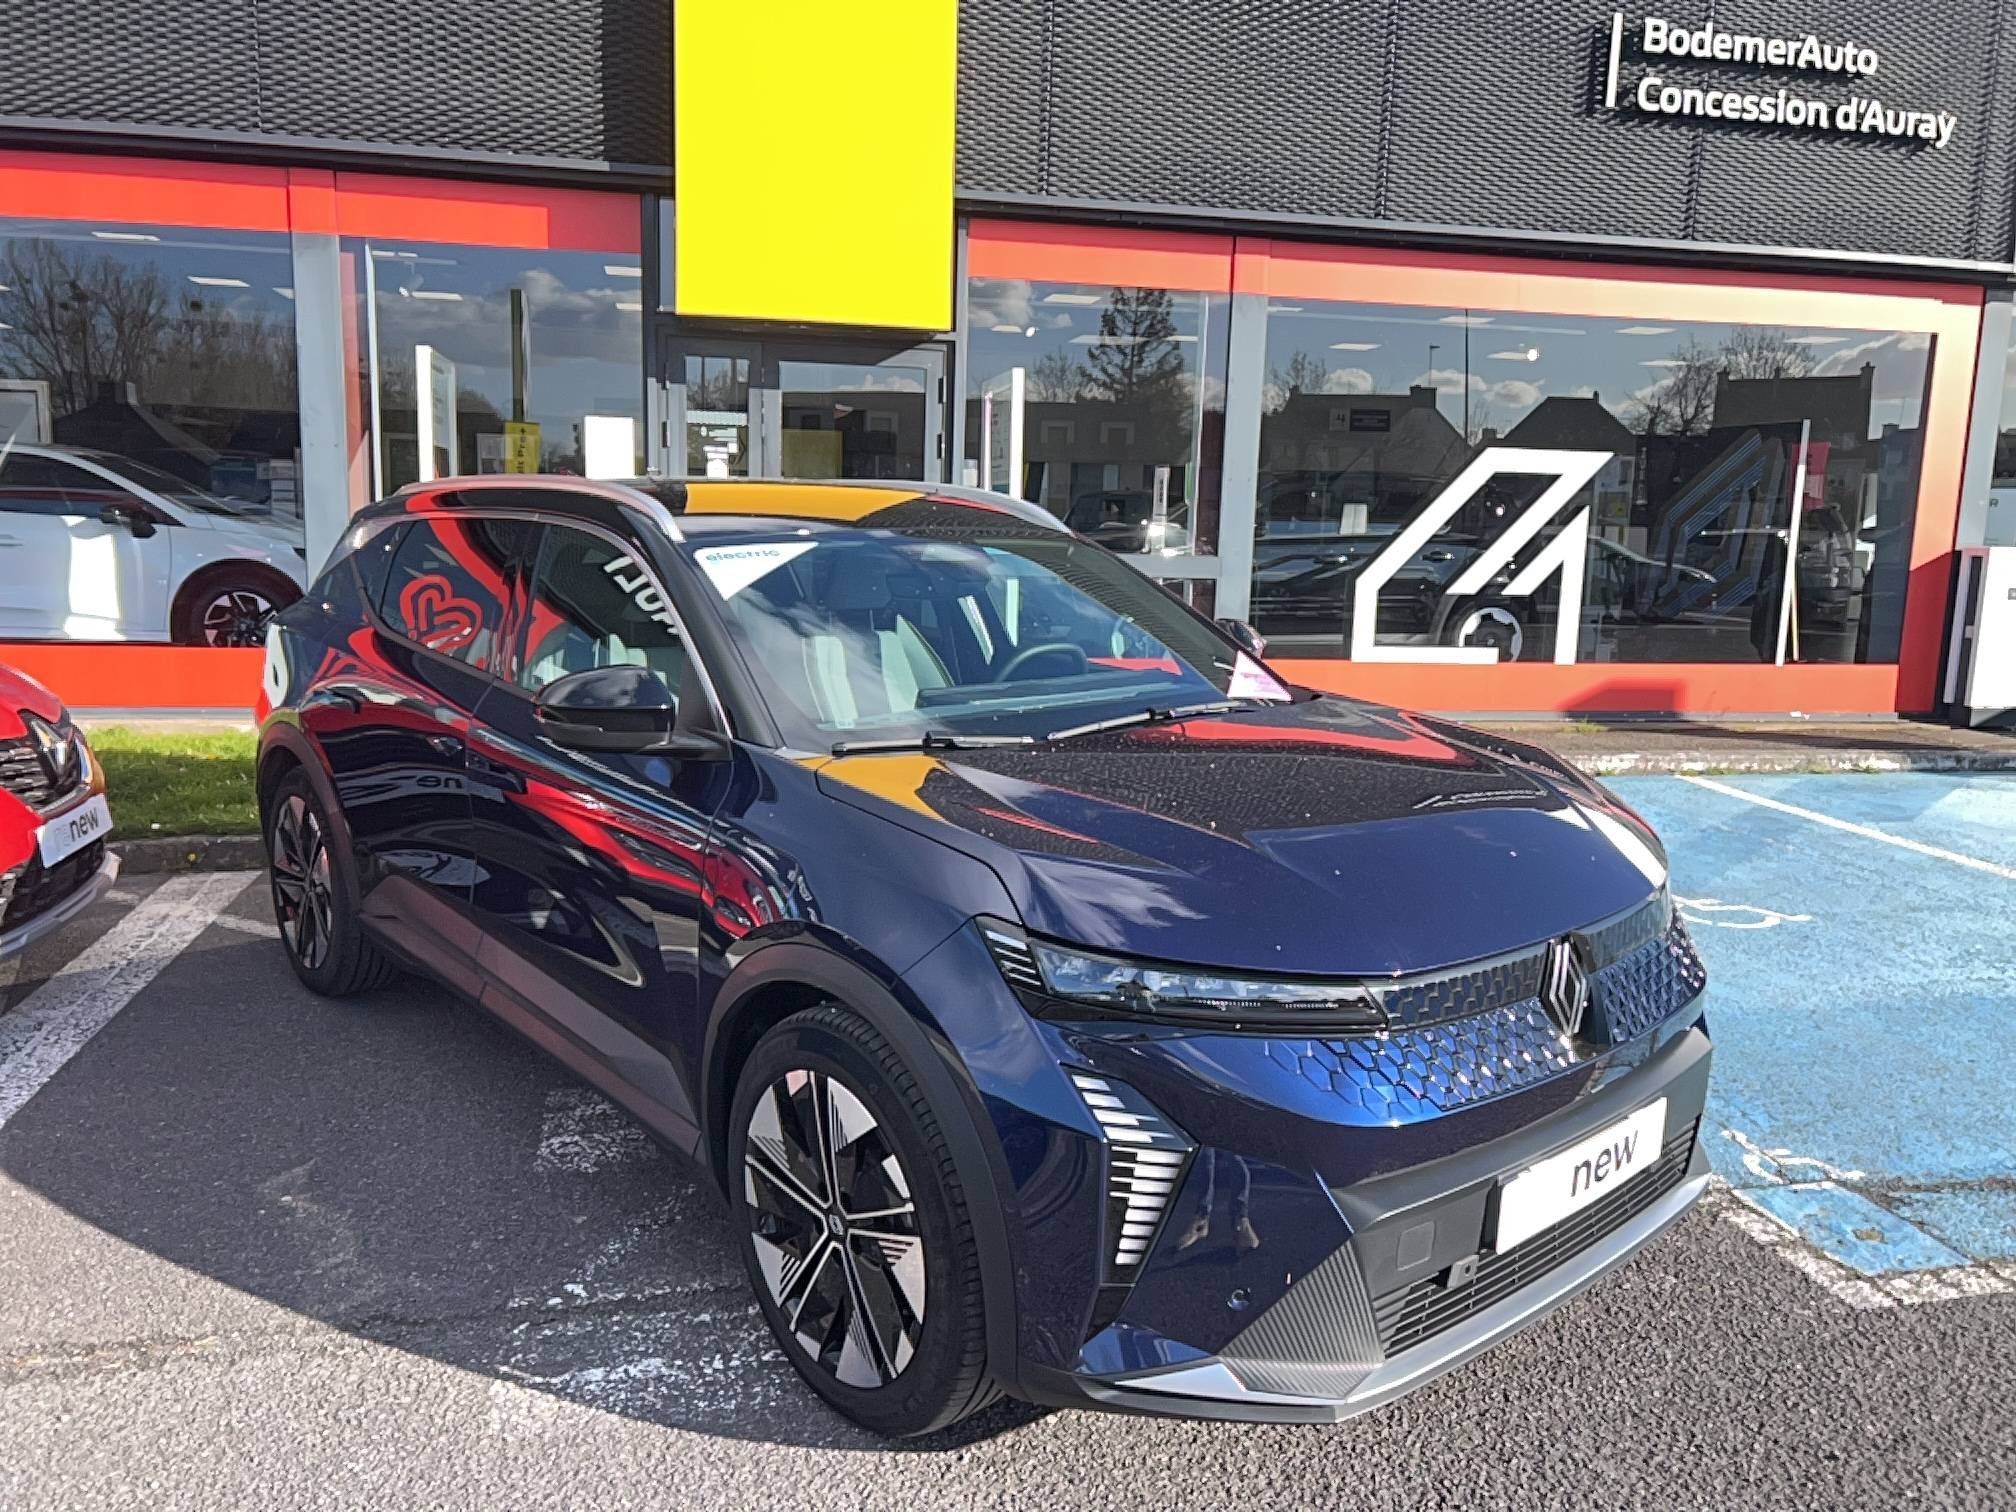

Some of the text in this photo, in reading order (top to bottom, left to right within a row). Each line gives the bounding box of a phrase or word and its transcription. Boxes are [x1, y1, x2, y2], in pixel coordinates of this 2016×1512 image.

[1643, 17, 1878, 75] BodemerAuto
[1637, 77, 1957, 148] Concession d'Auray
[706, 549, 780, 562] electric
[1571, 1129, 1638, 1198] new
